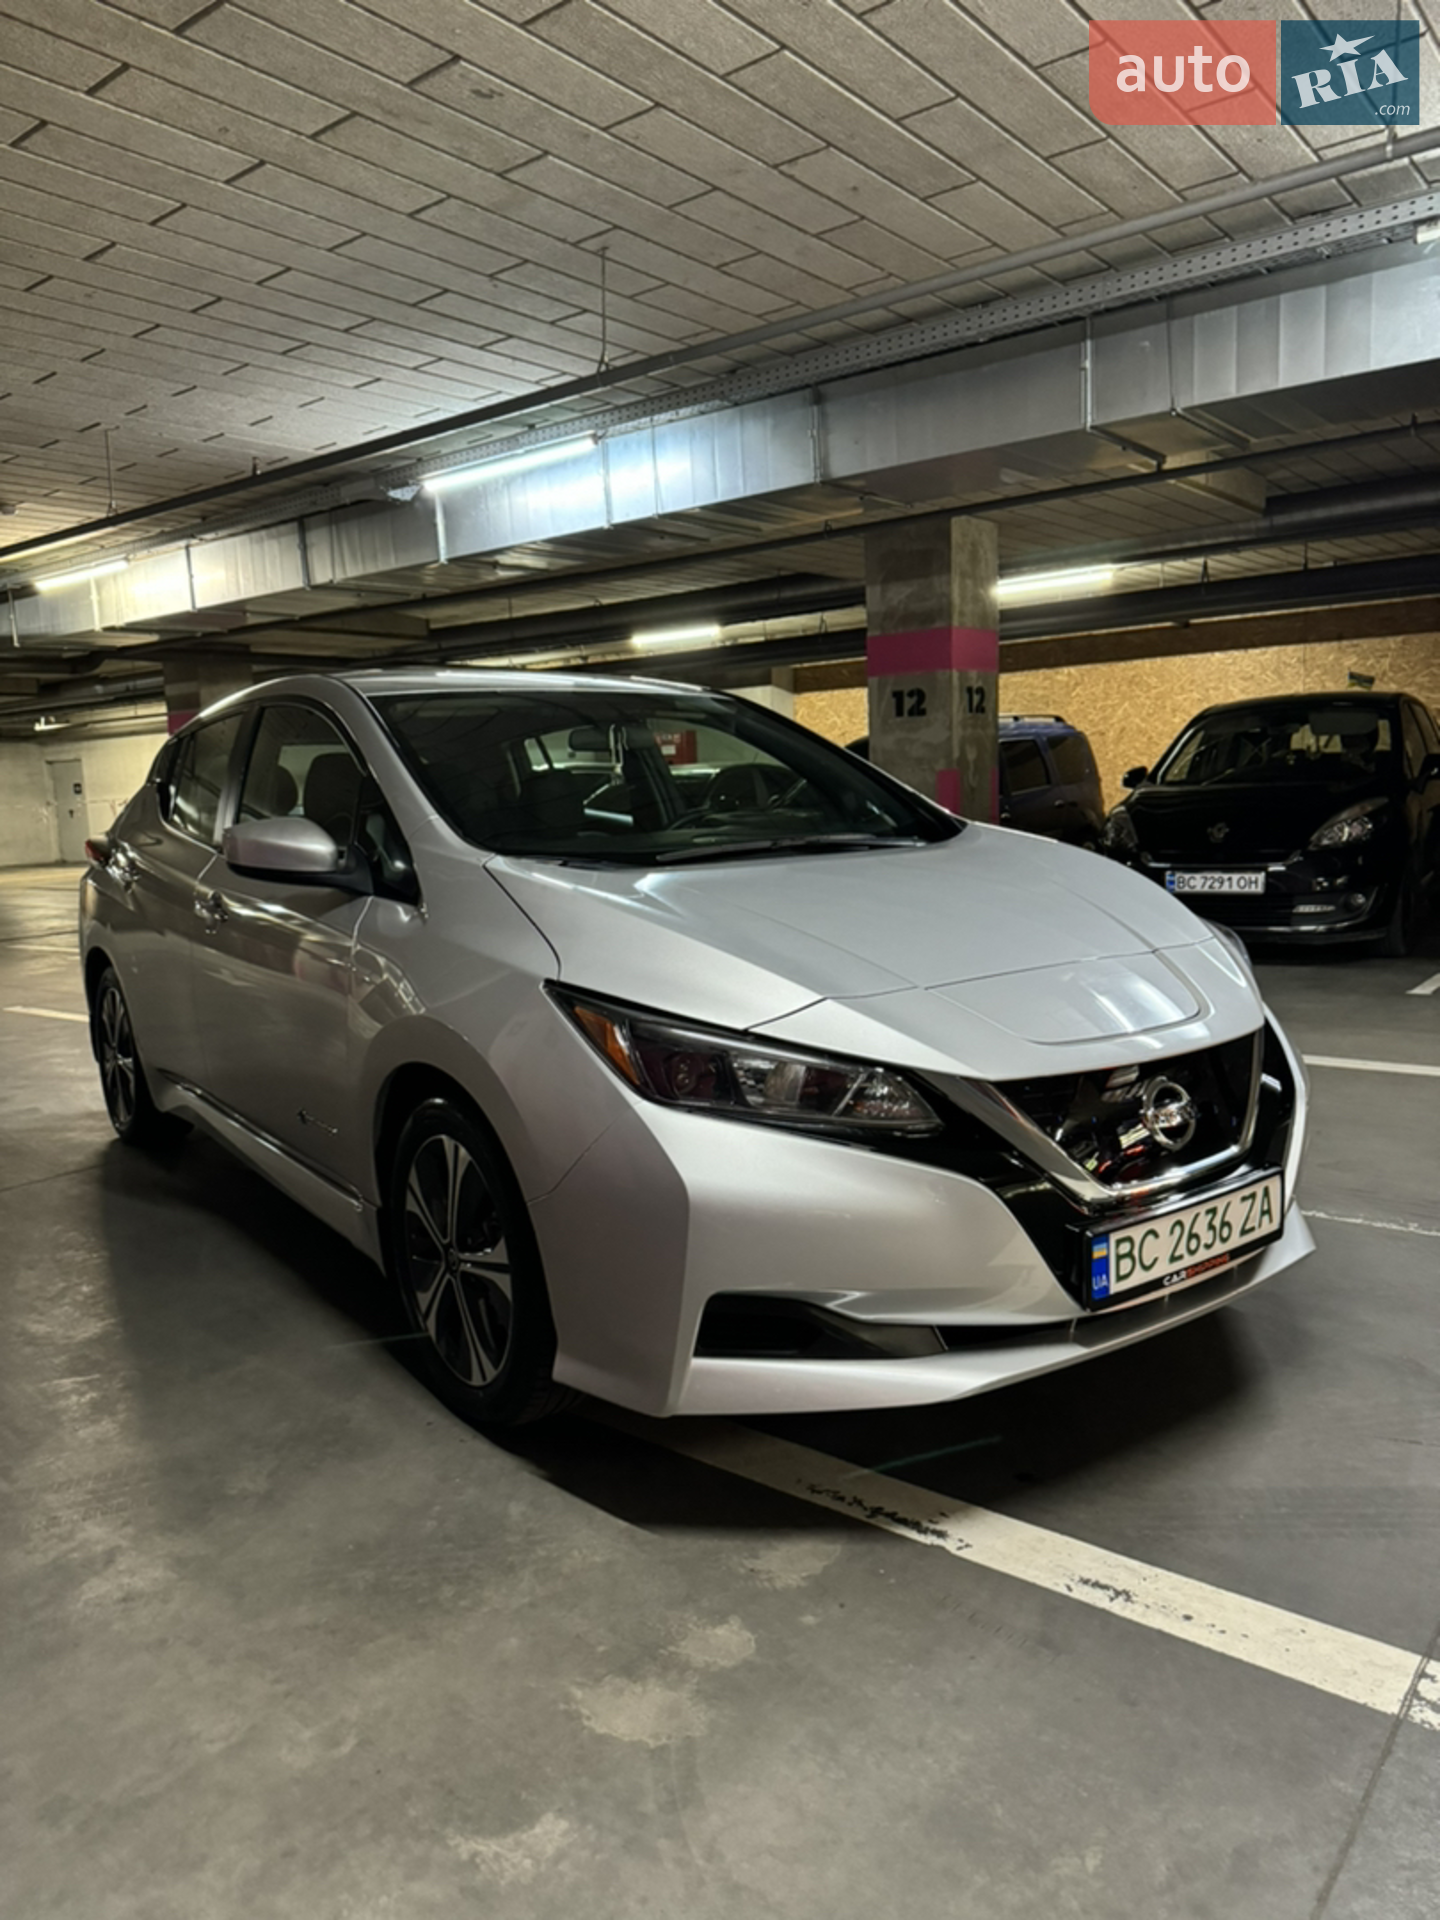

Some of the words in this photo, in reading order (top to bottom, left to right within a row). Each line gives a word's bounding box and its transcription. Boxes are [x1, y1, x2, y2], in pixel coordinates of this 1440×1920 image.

[892, 687, 927, 718] 12
[965, 686, 986, 714] 12
[1176, 876, 1197, 890] BC
[1200, 876, 1233, 890] 7291
[1236, 876, 1259, 890] OH
[1115, 1229, 1159, 1283] BC
[1169, 1201, 1232, 1264] 2636
[1239, 1185, 1273, 1237] ZA
[1092, 1273, 1109, 1290] UA
